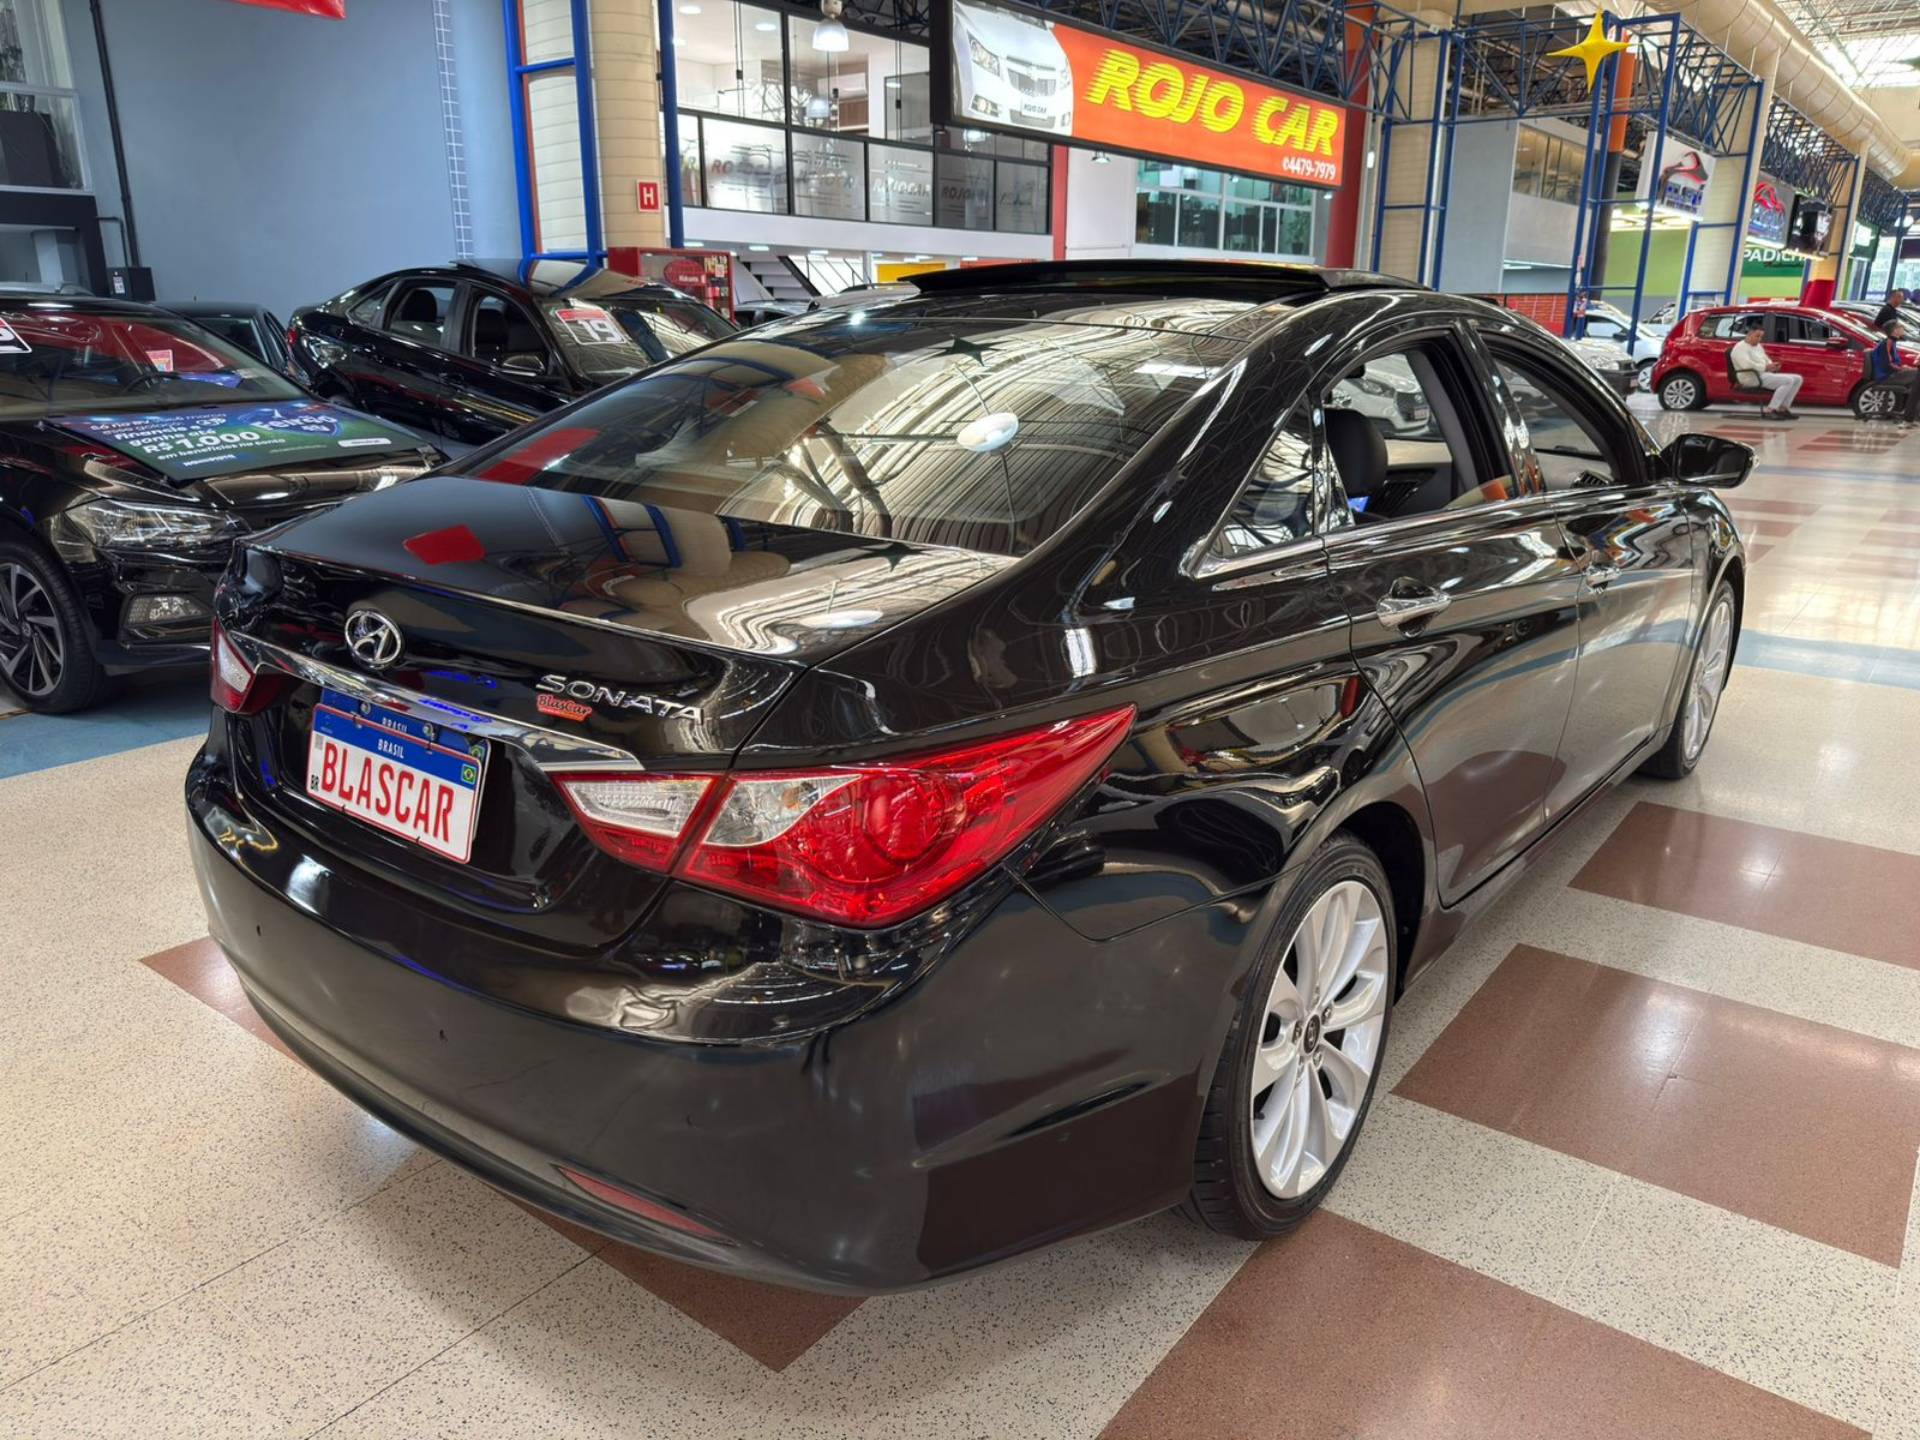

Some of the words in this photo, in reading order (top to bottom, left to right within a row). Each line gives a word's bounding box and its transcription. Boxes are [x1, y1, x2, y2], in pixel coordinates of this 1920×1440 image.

[1083, 48, 1245, 134] ROJO
[1251, 95, 1339, 156] CAR
[643, 186, 654, 206] H
[577, 319, 623, 342] 19
[143, 442, 173, 454] R$
[175, 431, 260, 450] 1.000
[536, 673, 704, 725] SONATA
[377, 738, 405, 759] BRASIL
[321, 742, 455, 843] BLASCAR
